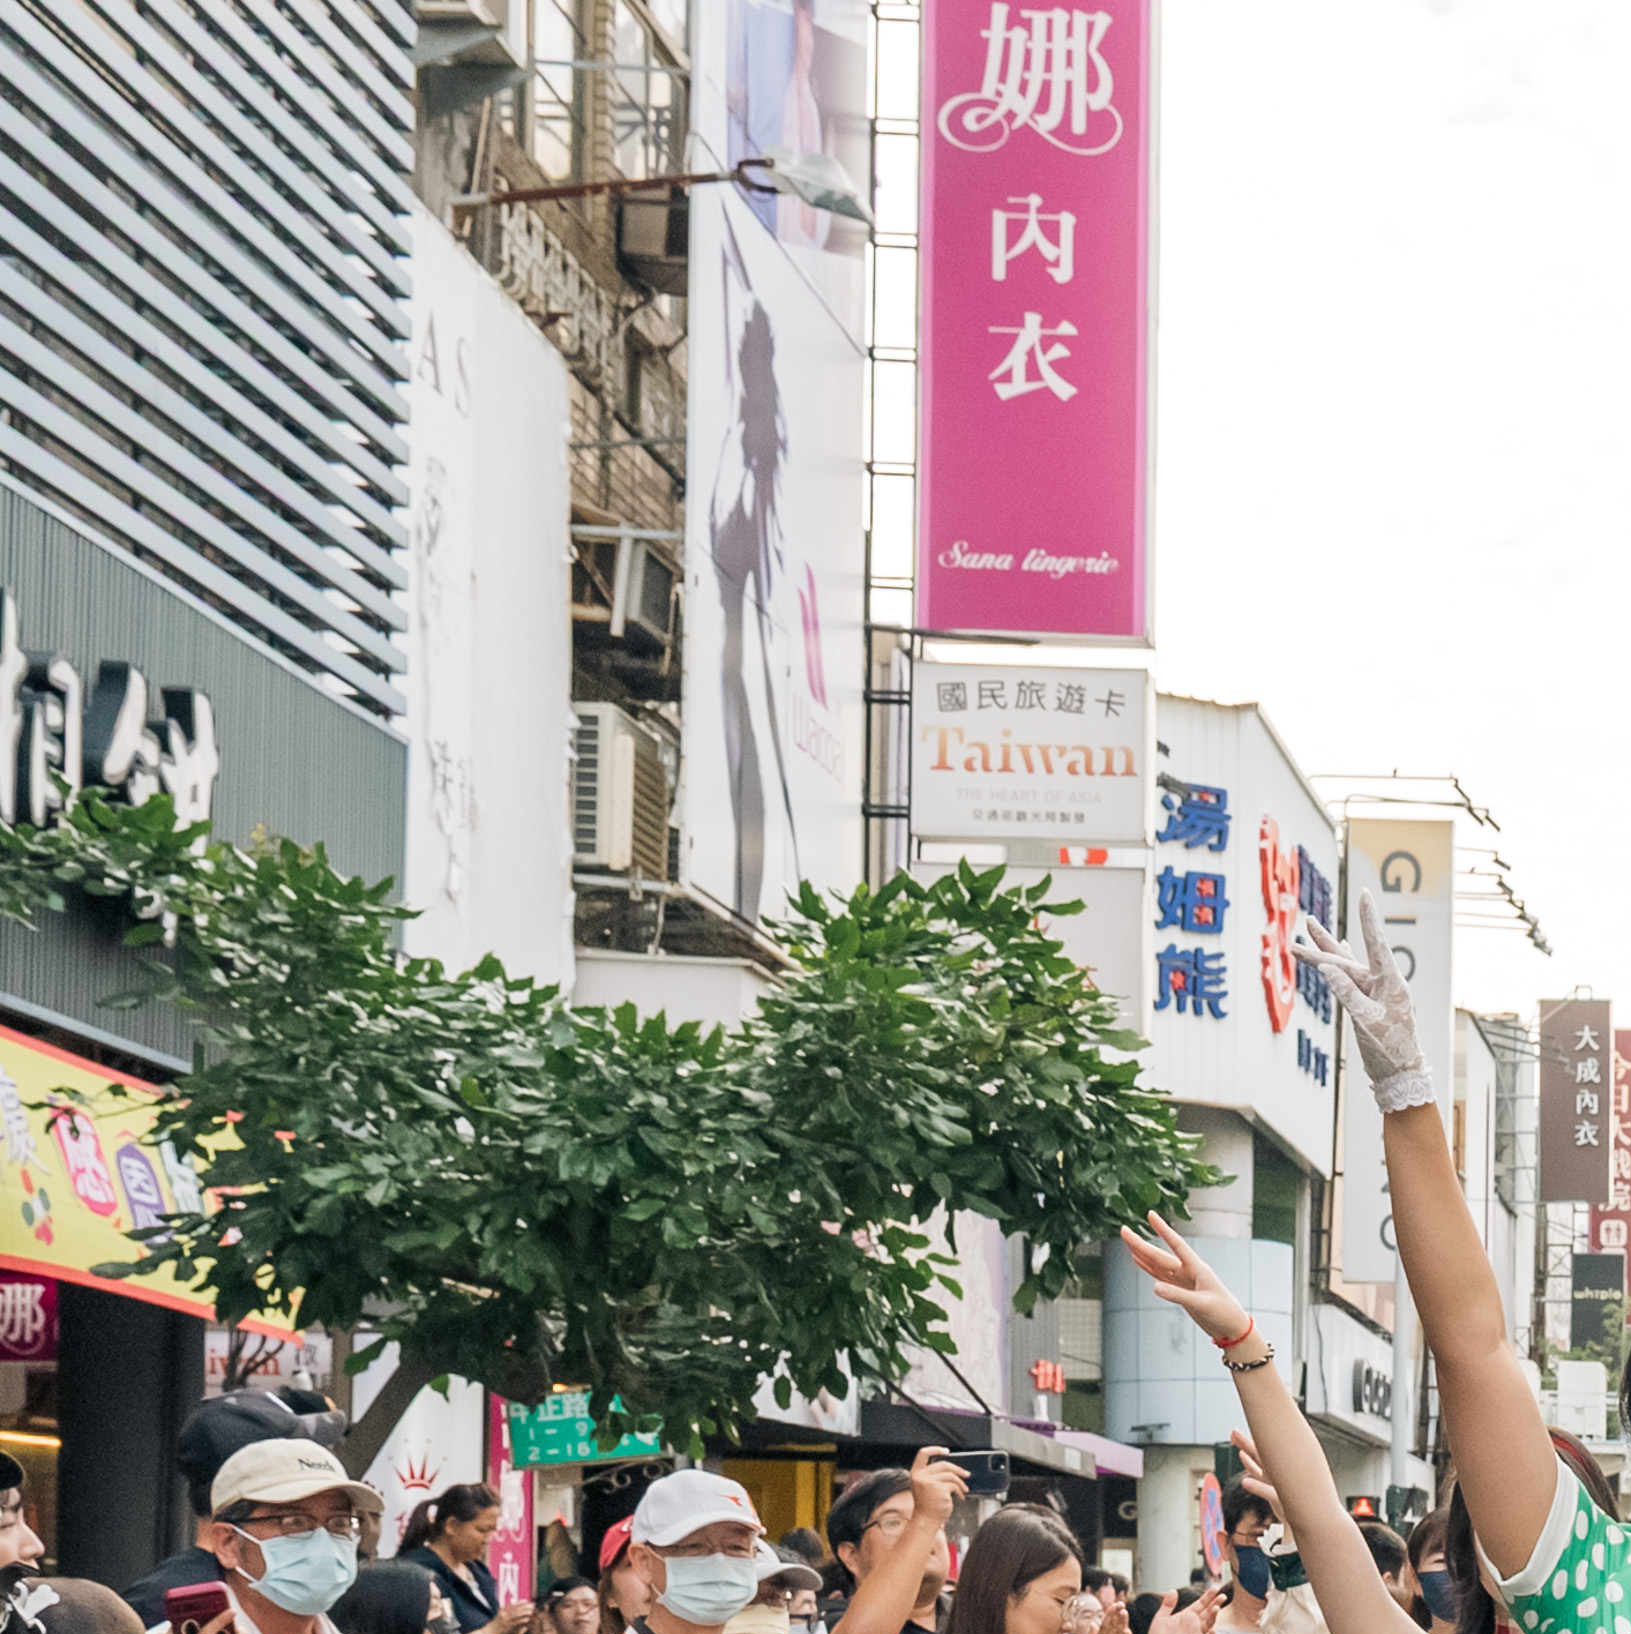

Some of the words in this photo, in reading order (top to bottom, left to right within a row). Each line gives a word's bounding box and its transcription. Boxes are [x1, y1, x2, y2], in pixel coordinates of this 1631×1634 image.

[938, 541, 1013, 571] Sana
[1022, 549, 1120, 580] lingerie
[936, 681, 1126, 718] 國民旅遊卡
[921, 725, 1138, 777] Taiwan
[1154, 782, 1233, 1020] 湯姆熊
[1573, 1023, 1602, 1148] 大成內衣
